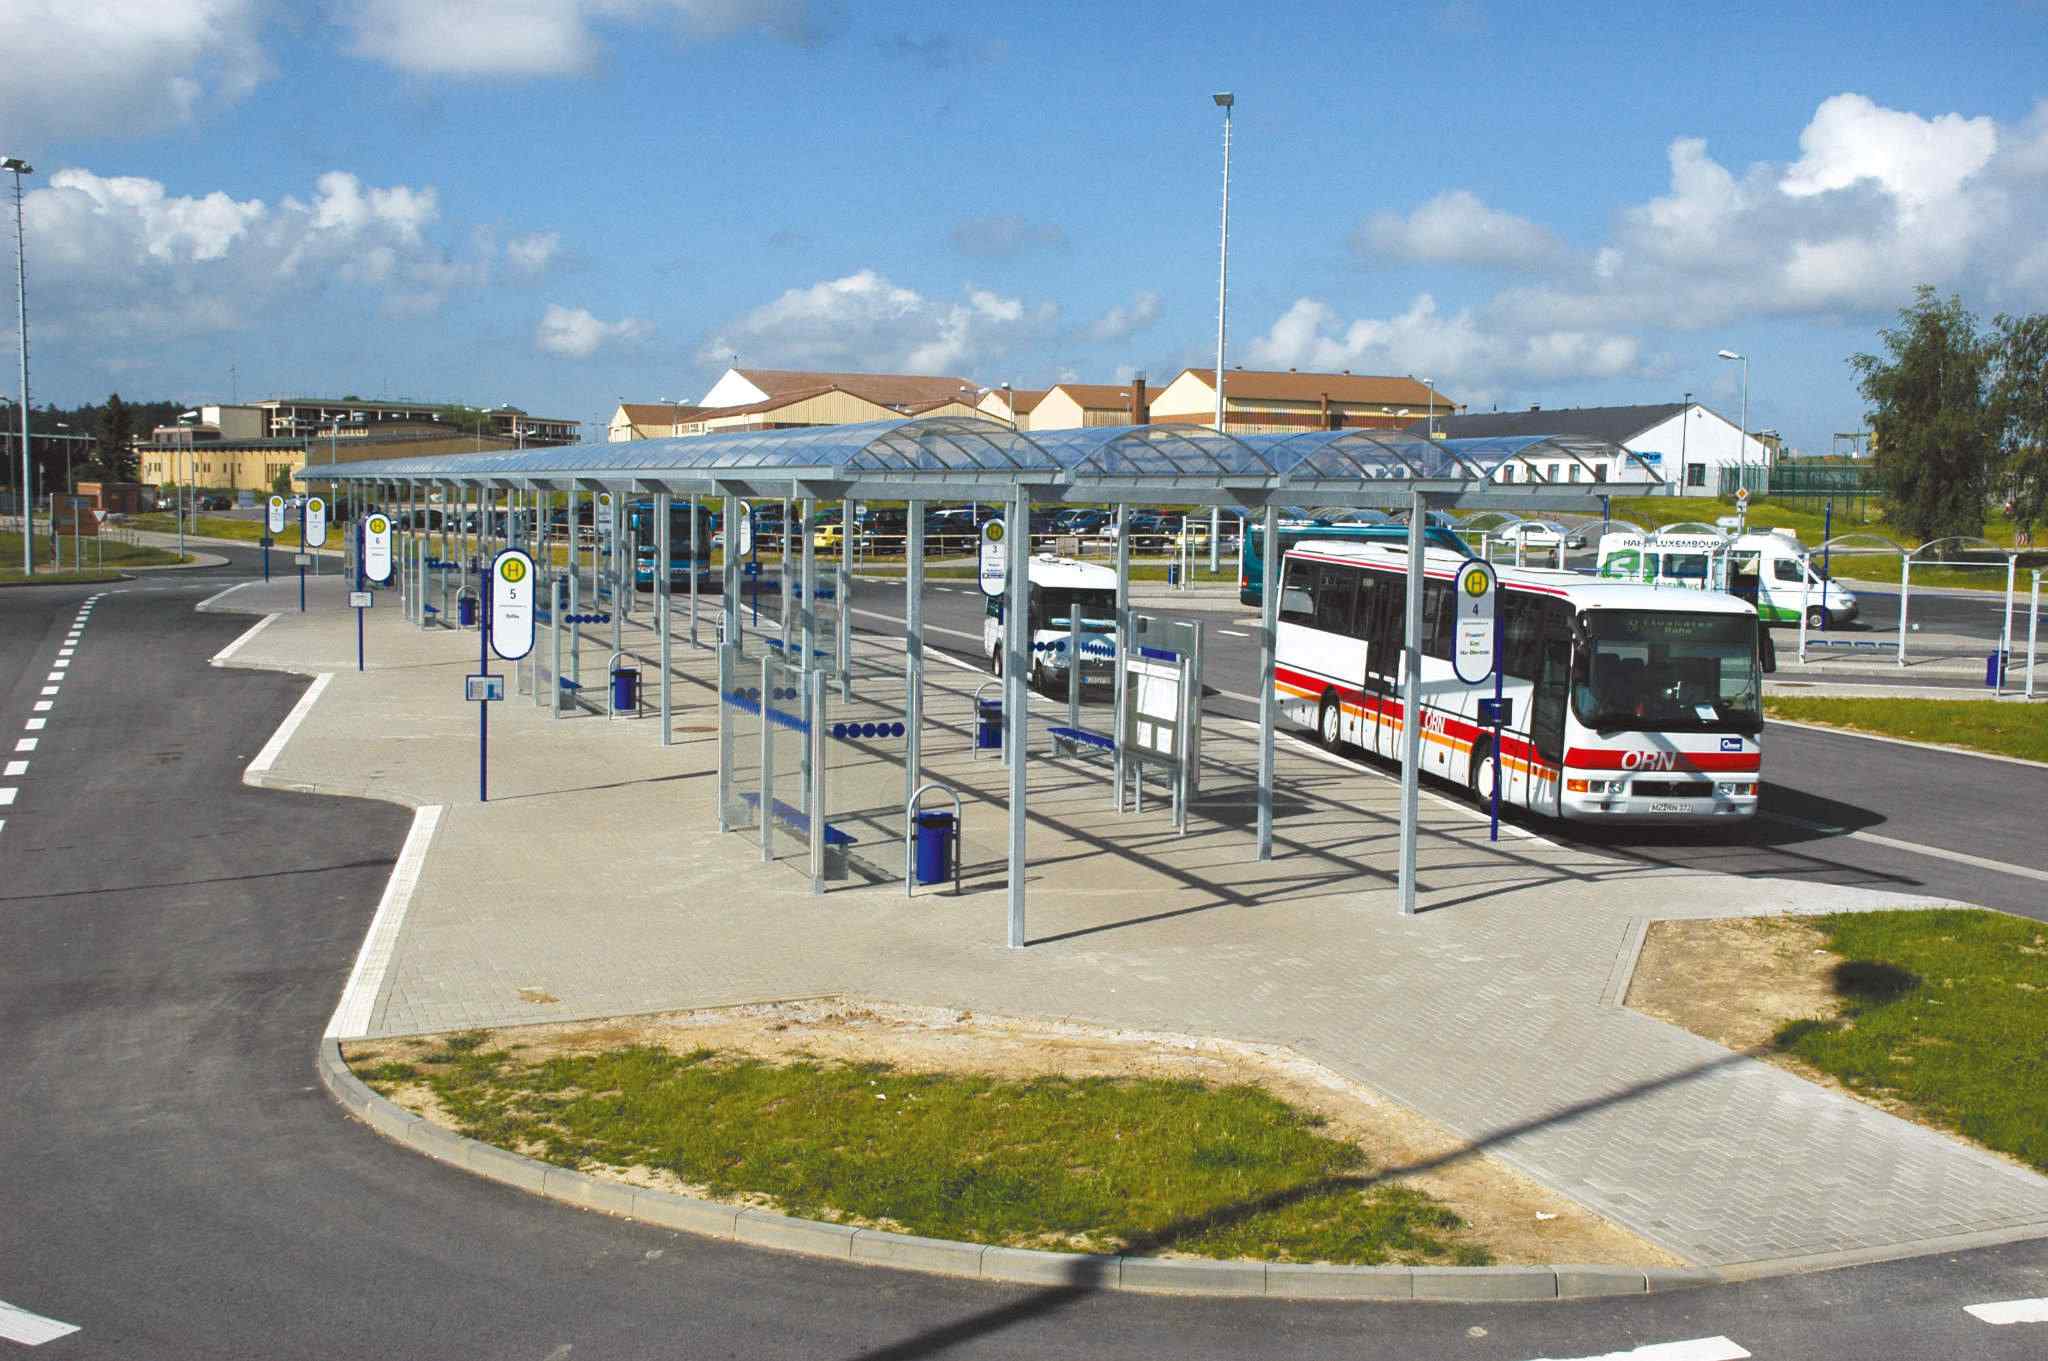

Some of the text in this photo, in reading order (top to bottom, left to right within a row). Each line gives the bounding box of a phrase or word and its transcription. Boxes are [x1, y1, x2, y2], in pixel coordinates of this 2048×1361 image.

[507, 562, 519, 578] H
[1471, 575, 1483, 592] H
[510, 588, 517, 599] 5
[1472, 604, 1479, 615] 4
[1425, 711, 1445, 735] ORN
[1621, 750, 1678, 771] ORN
